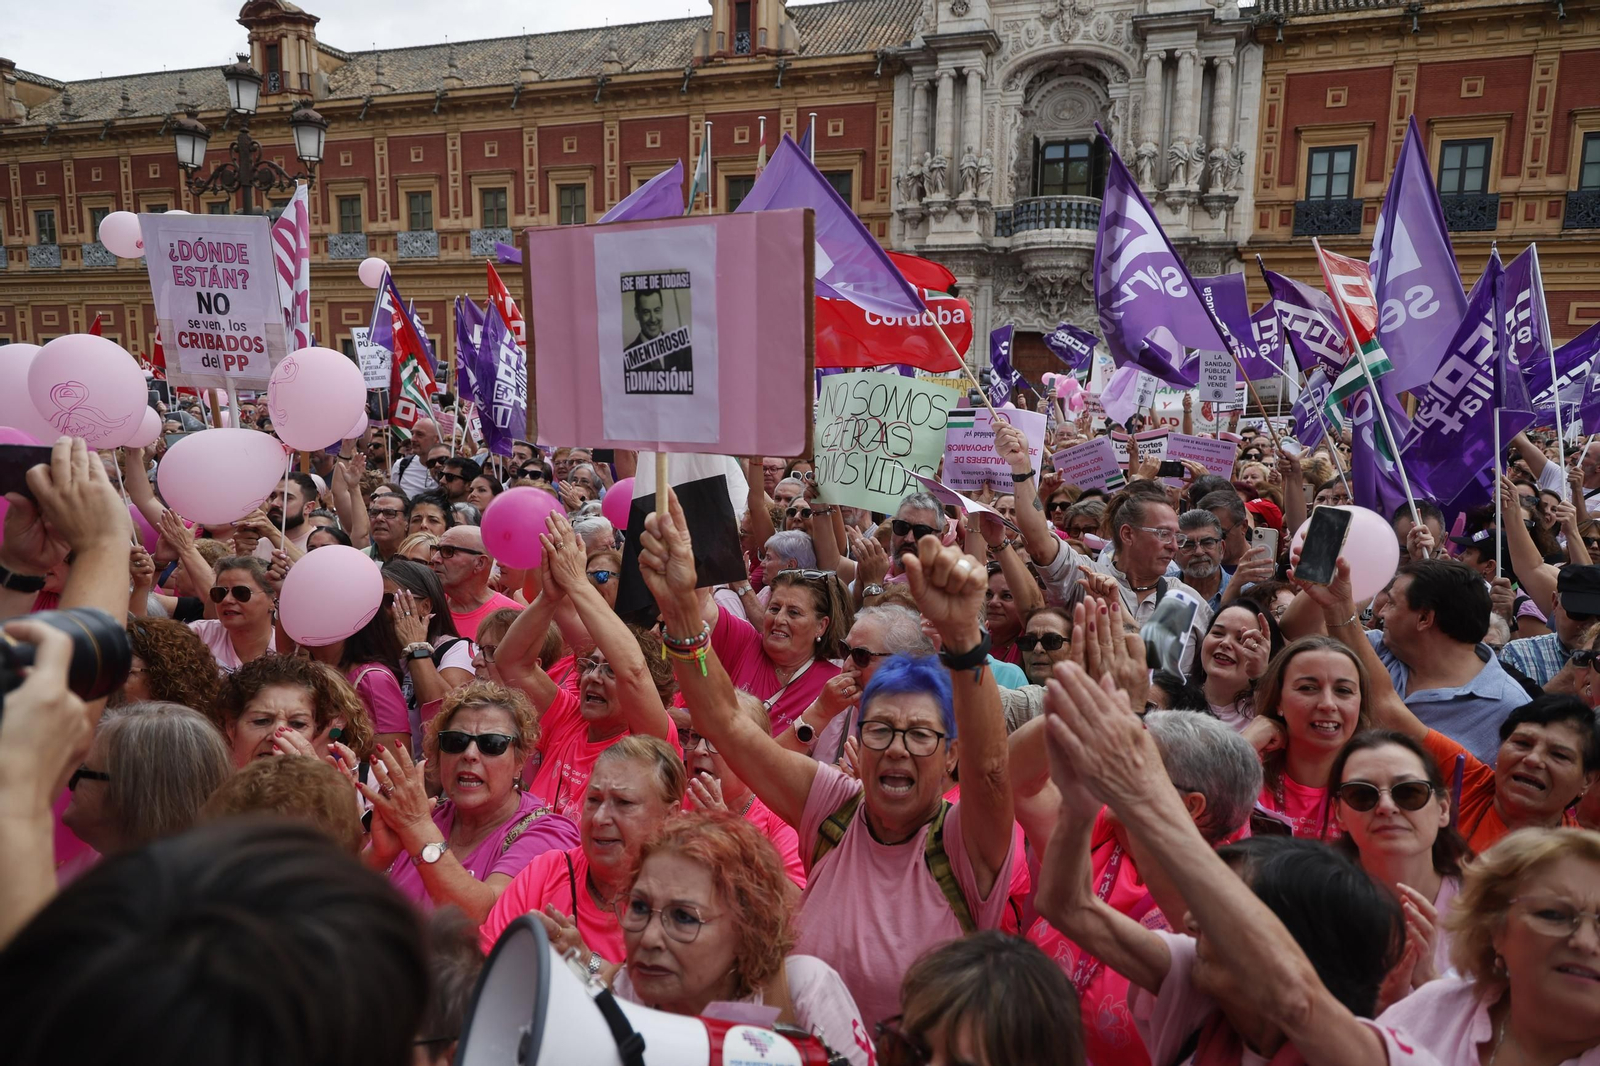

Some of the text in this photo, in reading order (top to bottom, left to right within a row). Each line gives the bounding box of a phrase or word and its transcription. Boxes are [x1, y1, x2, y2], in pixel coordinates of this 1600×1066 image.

[168, 237, 250, 264] ¿DÓNDE
[172, 264, 250, 290] ESTÁN?
[621, 273, 690, 291] ¡SE RIE DE TODAS!
[196, 292, 230, 316] NO
[188, 318, 247, 332] se ven, los
[178, 331, 264, 354] CRIBADOS
[625, 328, 690, 370] ¡MENTIROSO!
[202, 352, 249, 372] del PP
[626, 366, 693, 392] ¡DIMISIÓN!
[823, 380, 948, 430] NO SOMOS
[815, 452, 858, 486] SOMOS
[966, 457, 1006, 465] MUJERES
[1064, 462, 1089, 473] ESTAMOS
[1178, 452, 1205, 462] MUJERES
[1214, 457, 1233, 466] JEREZ
[1206, 463, 1222, 472] LADO
[1071, 465, 1101, 479] VOSOTRAS
